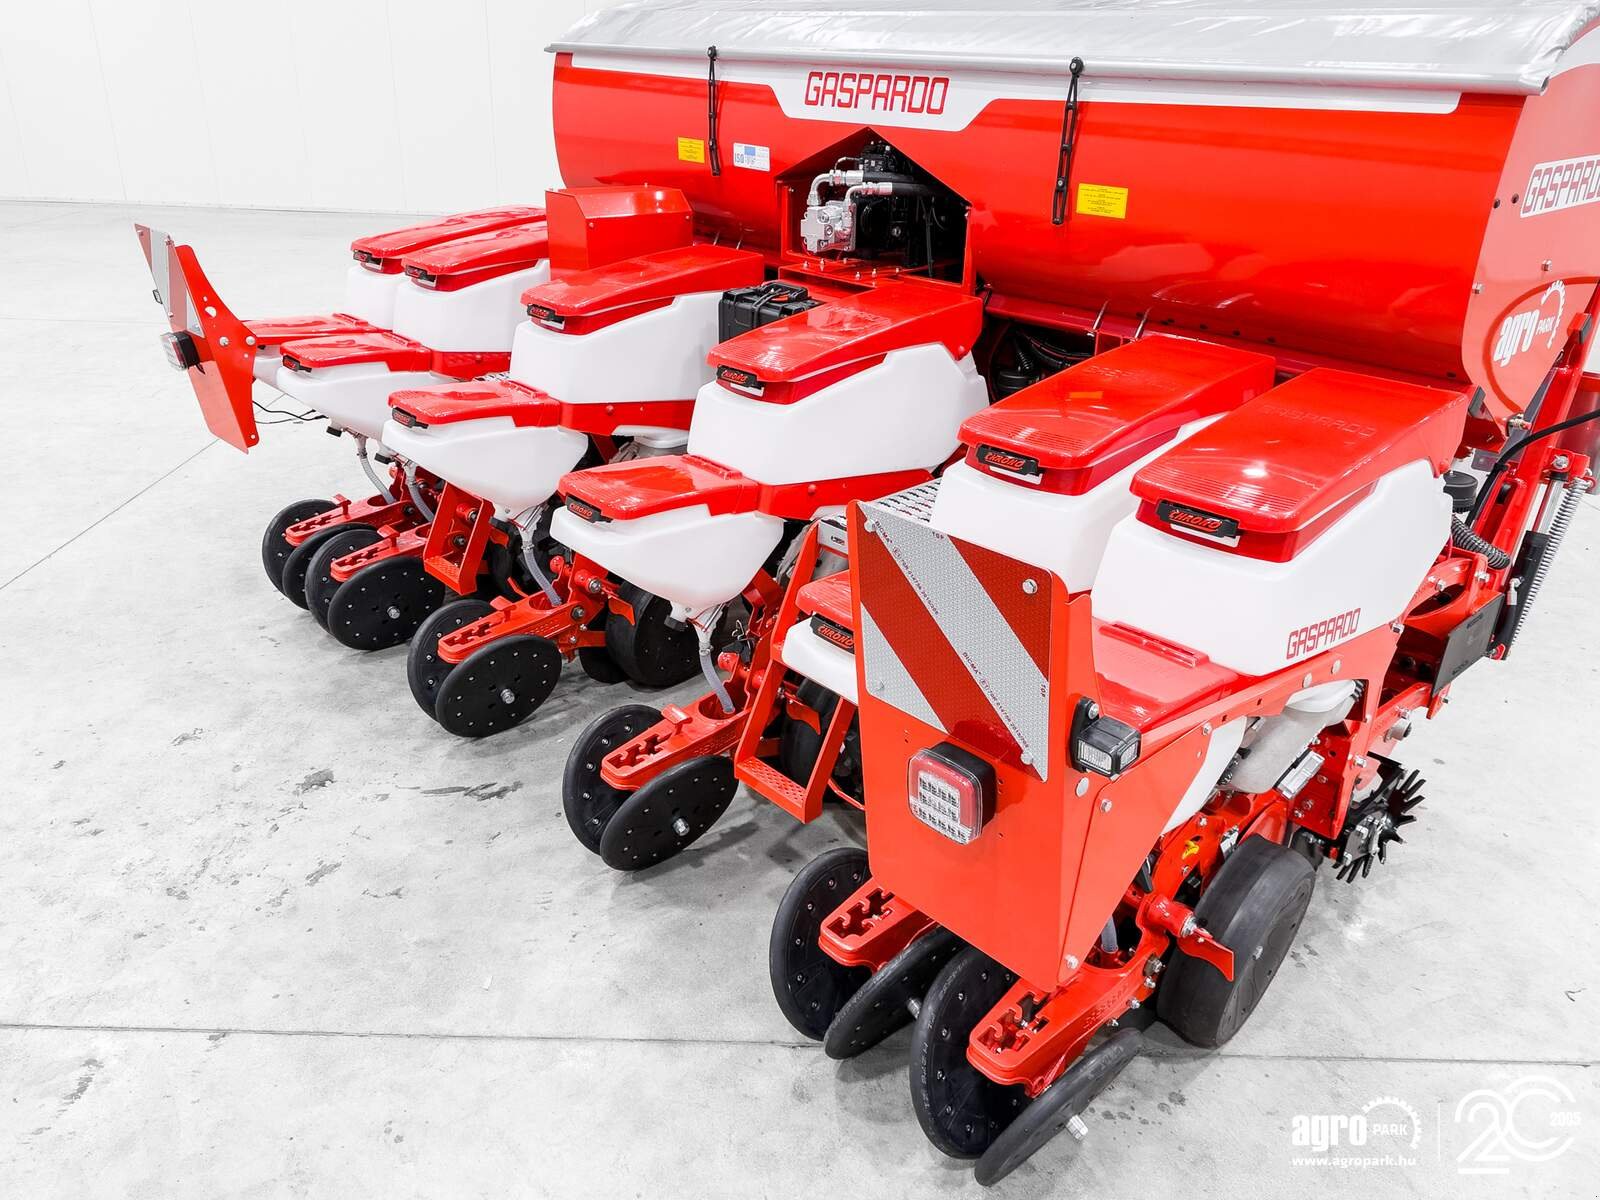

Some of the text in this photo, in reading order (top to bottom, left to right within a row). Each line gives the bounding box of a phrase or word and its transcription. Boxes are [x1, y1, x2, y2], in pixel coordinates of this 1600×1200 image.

[804, 71, 950, 115] GASPARDO
[1522, 159, 1600, 214] GASPARD
[1493, 308, 1540, 367] agro
[984, 451, 1026, 471] CHRONO
[1168, 509, 1223, 533] CHRONO
[1286, 607, 1361, 660] GASPARDO
